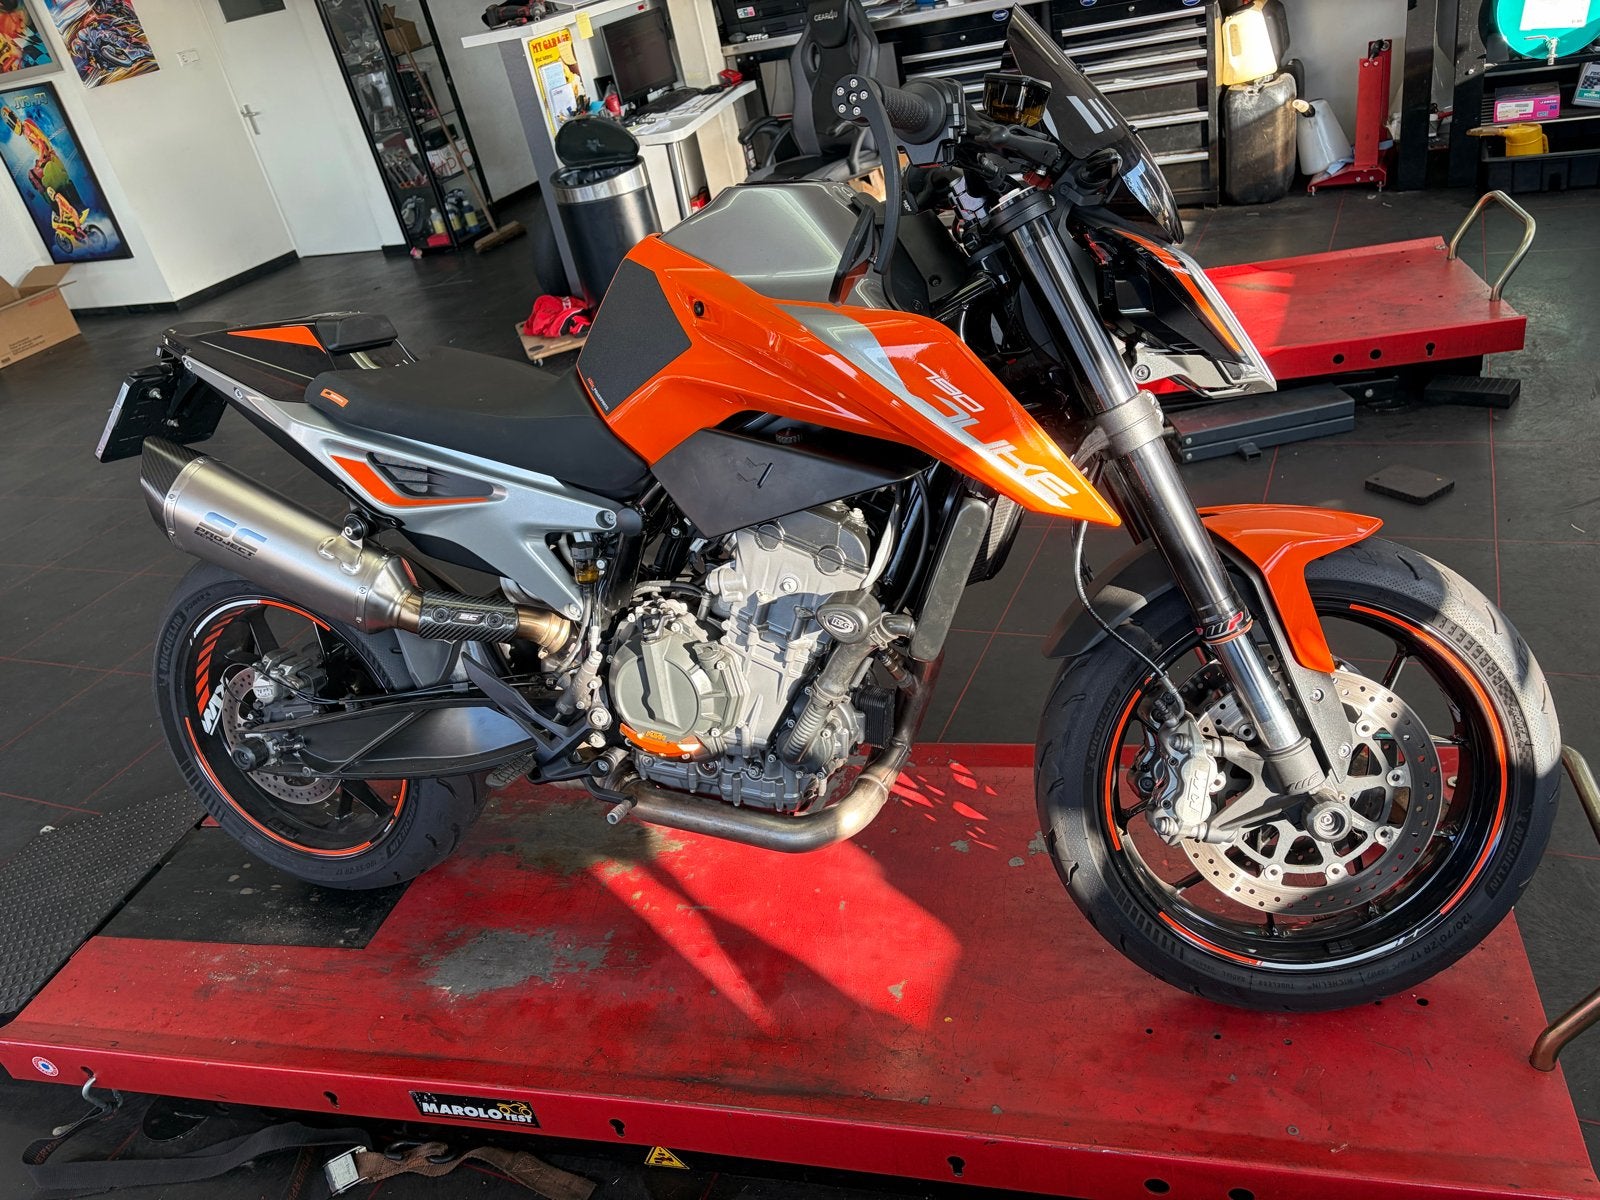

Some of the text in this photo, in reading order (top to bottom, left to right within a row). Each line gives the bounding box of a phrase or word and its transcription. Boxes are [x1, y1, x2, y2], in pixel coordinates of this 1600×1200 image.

[543, 33, 570, 49] GARAGE
[918, 363, 985, 412] 790
[932, 394, 1079, 510] DUKE
[195, 526, 255, 557] PROJECT
[199, 512, 267, 553] SC
[158, 616, 184, 673] MICHELIN
[1088, 686, 1121, 758] MICHELIN
[1509, 704, 1526, 733] FRONT
[1489, 823, 1527, 892] MICHELIN
[1441, 911, 1473, 943] 120/70
[1423, 937, 1439, 955] ZR
[421, 1101, 533, 1123] MAROLO TEST
